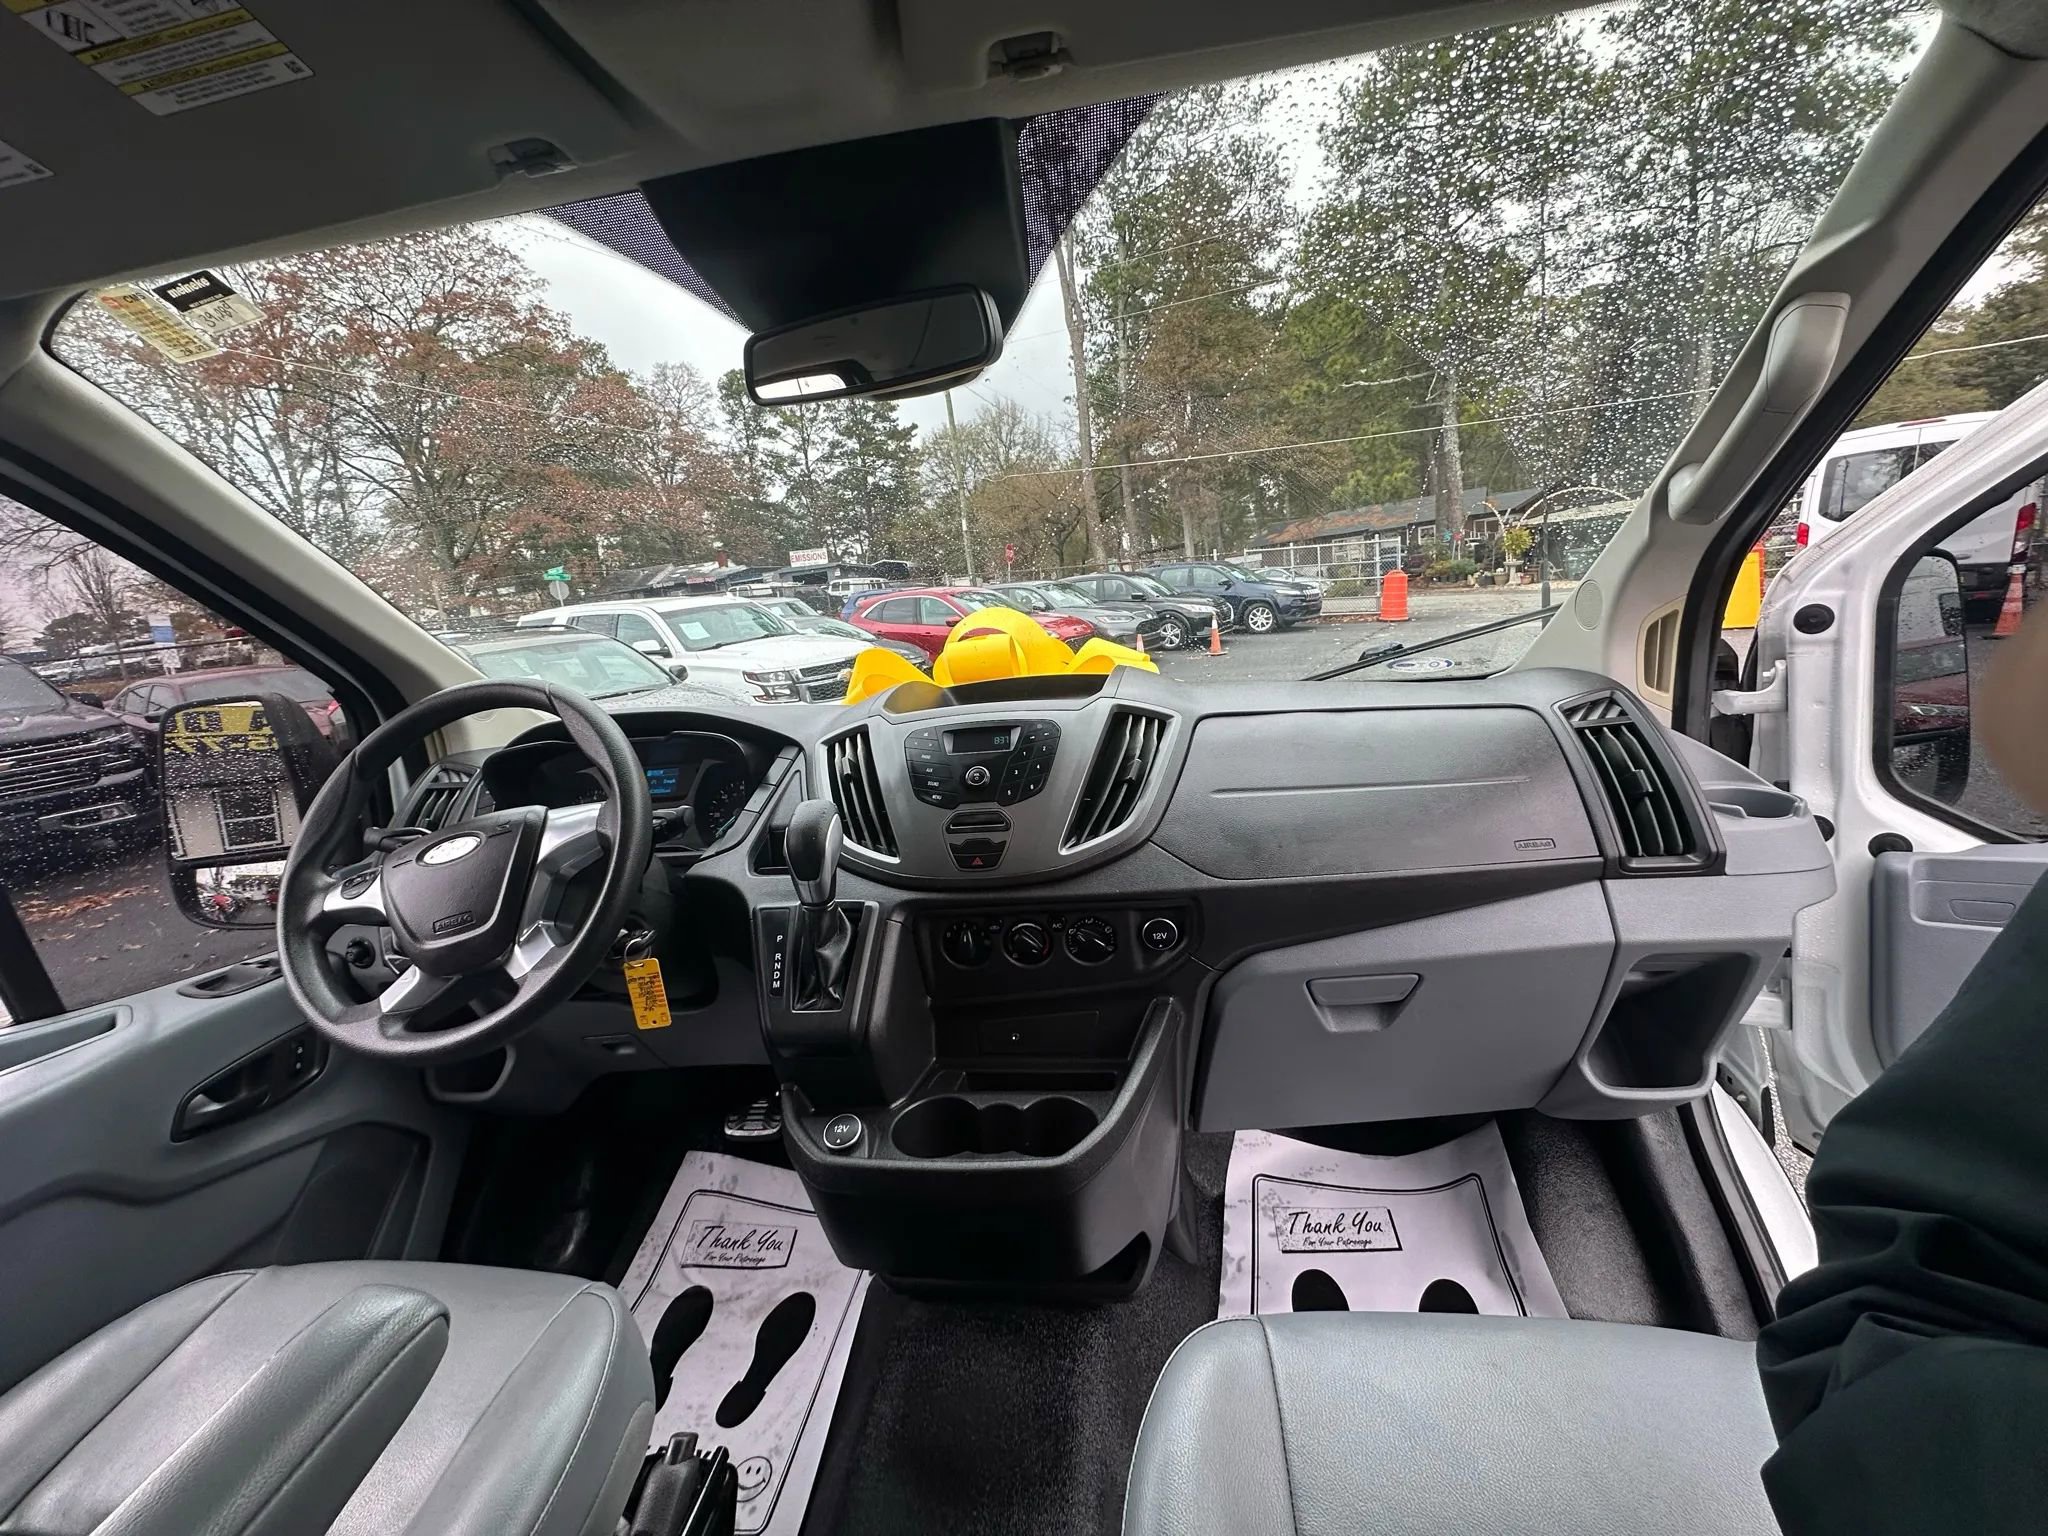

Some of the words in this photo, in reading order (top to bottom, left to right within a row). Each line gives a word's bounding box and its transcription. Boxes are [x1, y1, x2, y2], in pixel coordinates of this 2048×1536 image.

[167, 277, 211, 298] meineke
[791, 551, 827, 563] EMISSIONS
[436, 914, 472, 930] AIRBAG
[1152, 932, 1168, 940] 12V
[833, 1124, 850, 1133] 12V
[1288, 1211, 1346, 1235] Thank
[1351, 1210, 1384, 1235] You
[696, 1225, 757, 1252] Thank
[757, 1229, 784, 1253] You
